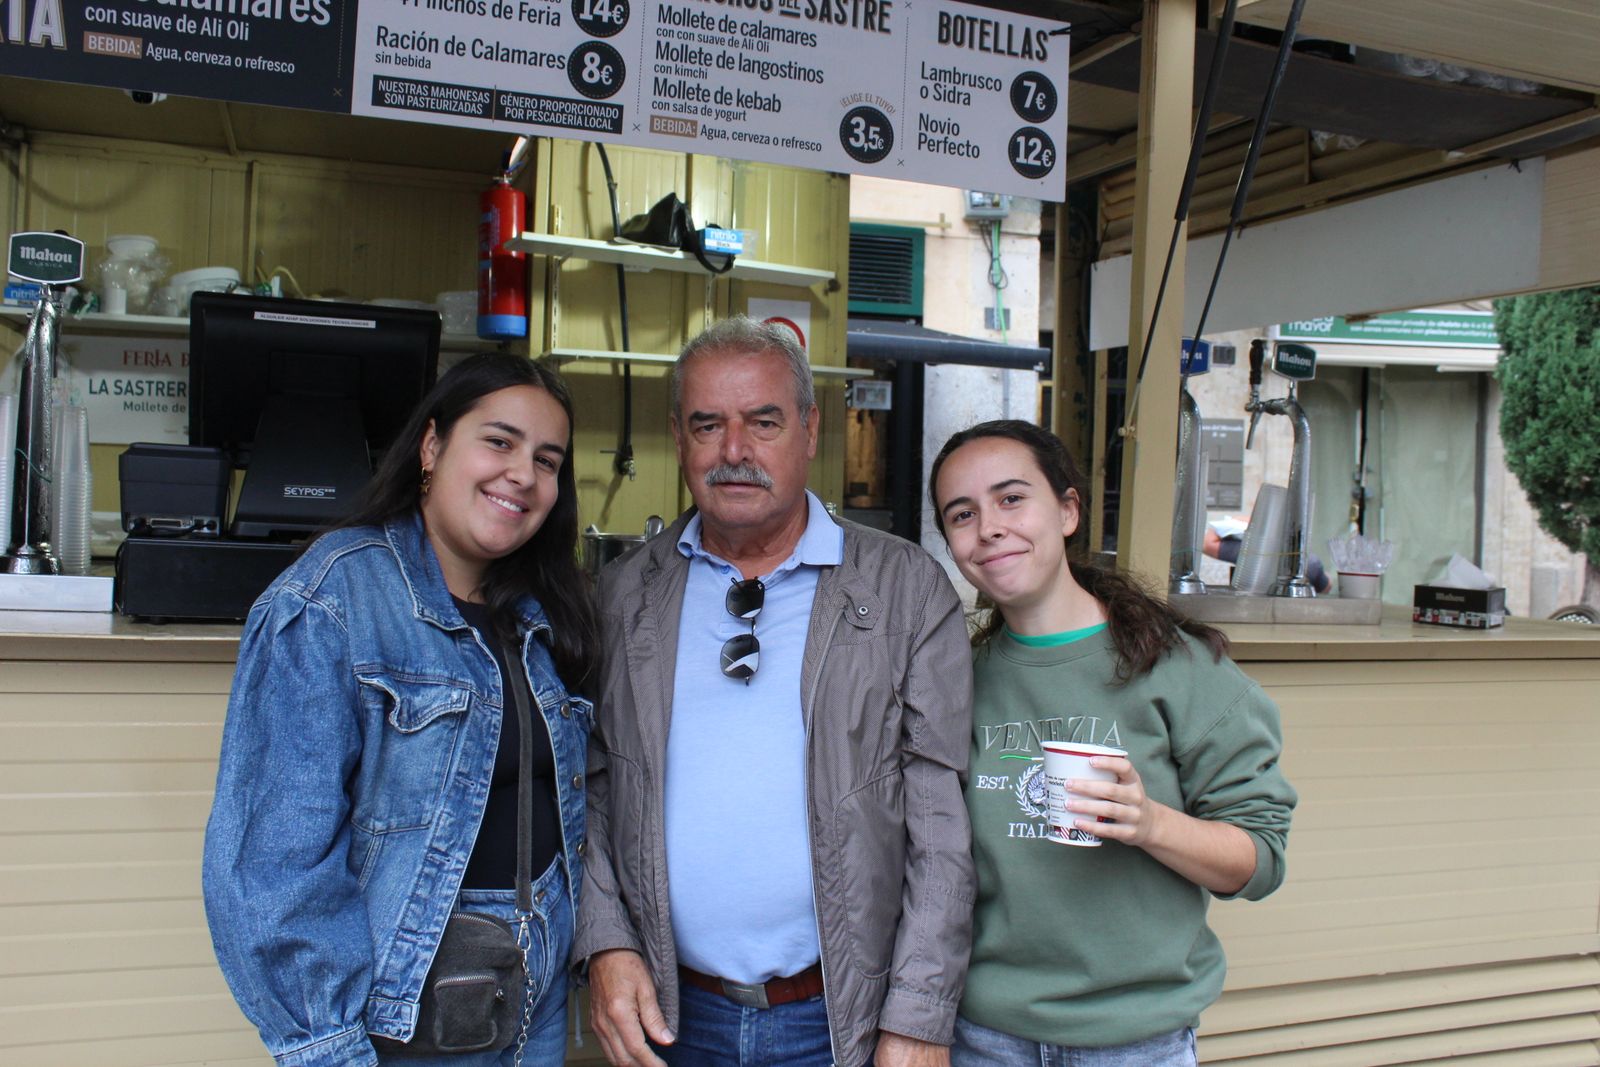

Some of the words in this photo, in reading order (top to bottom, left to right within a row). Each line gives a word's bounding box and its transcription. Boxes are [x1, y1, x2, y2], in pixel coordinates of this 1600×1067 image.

[84, 6, 117, 24] con
[121, 10, 171, 31] suave
[176, 14, 197, 34] de
[200, 17, 222, 38] Ali
[227, 20, 249, 41] Oli
[491, 0, 513, 21] de
[519, 2, 561, 27] Feria
[579, 0, 624, 25] 14€
[804, 0, 892, 34] SASTRE
[657, 4, 715, 31] Mollete
[718, 15, 738, 35] de
[740, 19, 817, 48] calamares
[938, 11, 1048, 62] BOTELLAS
[377, 25, 439, 54] Ración
[444, 35, 466, 57] de
[471, 39, 566, 70] Calamares
[656, 29, 675, 39] con
[677, 31, 695, 42] con
[697, 34, 726, 46] suave
[728, 36, 740, 48] de
[741, 39, 754, 51] Ali
[756, 41, 770, 53] Oli
[88, 35, 140, 56] BEBIDA:
[146, 45, 181, 61] Agua,
[184, 52, 231, 67] cerveza
[234, 57, 242, 68] o
[245, 57, 295, 74] refresco
[375, 52, 392, 64] sin
[395, 54, 431, 69] bebida
[655, 41, 713, 67] Mollete
[716, 50, 735, 70] de
[738, 53, 824, 84] langostinos
[582, 51, 613, 85] 8€
[654, 64, 673, 75] con
[674, 65, 708, 79] kimchi
[921, 61, 1002, 92] Lambrusco
[378, 80, 429, 96] NUESTRAS
[431, 86, 490, 104] MAHONESAS
[384, 93, 405, 105] SON
[407, 95, 483, 115] PASTEURIZADAS
[653, 77, 711, 103] Mollete
[714, 86, 733, 105] de
[736, 88, 782, 113] kebab
[920, 86, 929, 99] o
[933, 83, 971, 106] Sidra
[1022, 80, 1046, 111] 7€
[501, 92, 537, 109] GÉNERO
[539, 99, 619, 119] PROPORCIONADO
[651, 100, 670, 111] con
[672, 102, 698, 115] salsa
[700, 105, 713, 117] de
[715, 109, 747, 122] yogurt
[505, 107, 524, 119] POR
[526, 110, 583, 127] PESCADERÍA
[584, 116, 613, 130] LOCAL
[918, 113, 960, 136] Novio
[653, 118, 696, 136] BEBIDA:
[700, 124, 730, 141] Agua,
[732, 132, 770, 146] cerveza
[772, 137, 779, 147] o
[781, 136, 822, 152] refresco
[917, 132, 980, 158] Perfecto
[1015, 136, 1052, 167] 12€
[20, 246, 72, 263] Mahou
[1279, 352, 1312, 366] Mahou
[89, 379, 108, 395] LA
[114, 379, 187, 397] SASTRER
[124, 402, 168, 413] Mollete
[172, 402, 186, 413] de
[284, 487, 325, 496] SEYPOS
[980, 715, 1123, 752] VENEZIA
[976, 775, 1012, 790] EST.
[1007, 822, 1048, 838] ITAL
